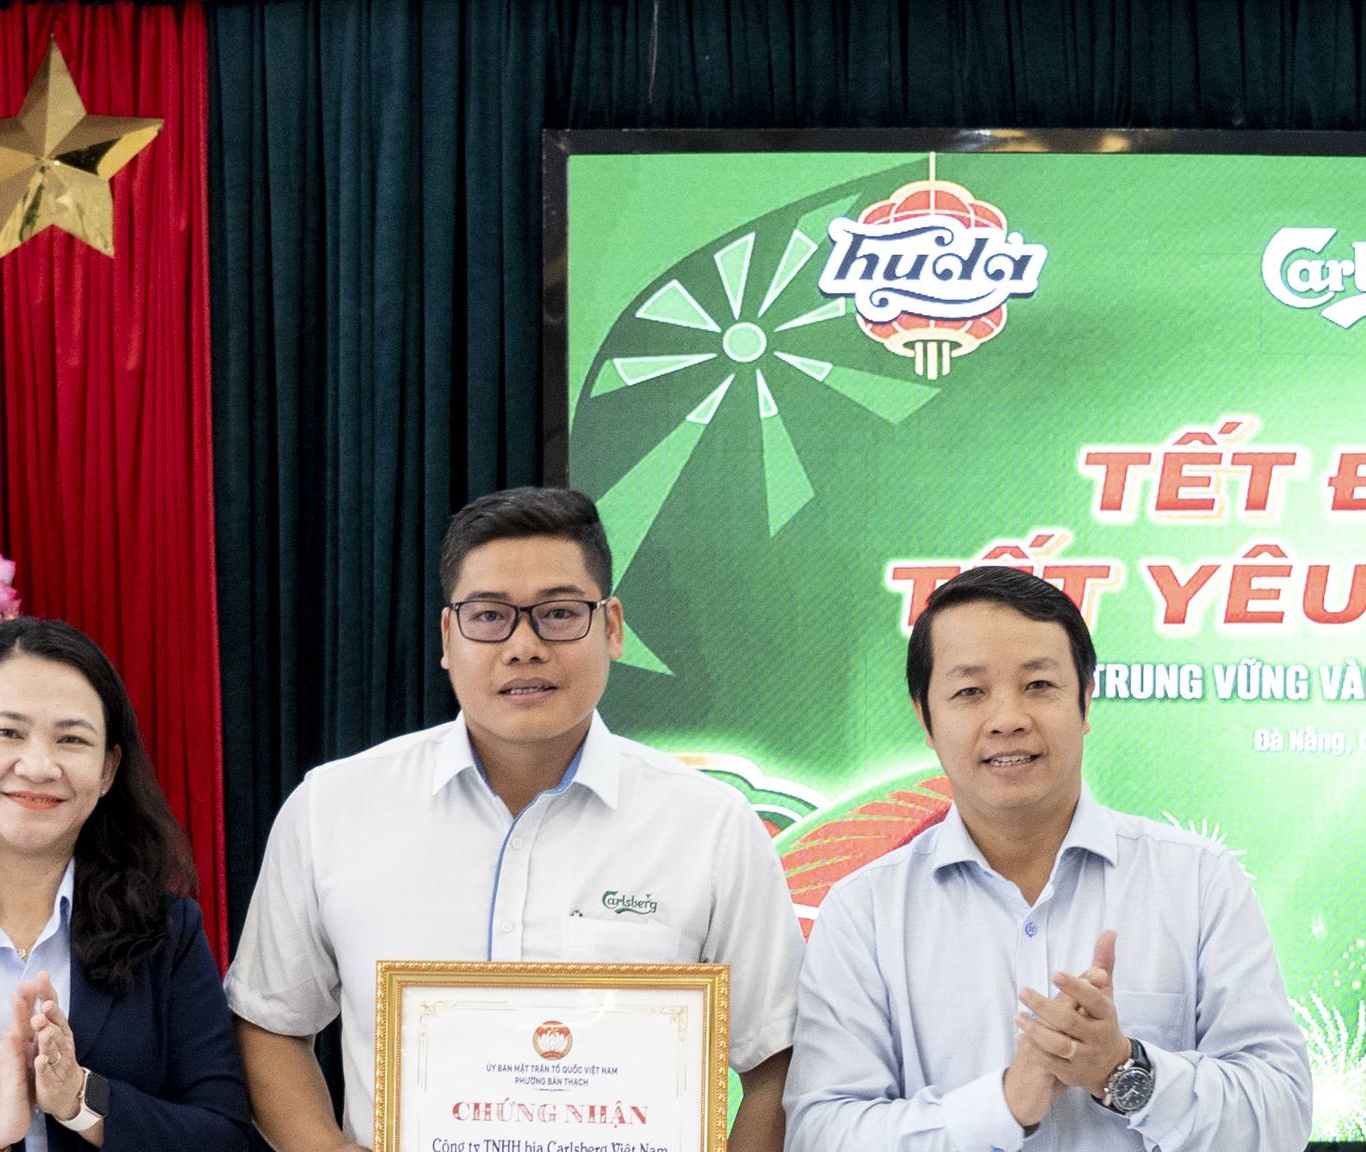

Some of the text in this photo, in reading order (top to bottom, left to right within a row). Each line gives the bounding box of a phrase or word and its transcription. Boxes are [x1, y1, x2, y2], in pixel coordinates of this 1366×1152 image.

[833, 225, 1035, 304] huda
[1085, 421, 1297, 512] TẾT
[891, 534, 1111, 626] TT
[1092, 662, 1204, 700] TRUNG
[1213, 658, 1310, 700] VỮNG
[601, 891, 658, 914] Carlsberg
[497, 1064, 512, 1073] BAN
[452, 1097, 649, 1129] CHỨNG NHẬN
